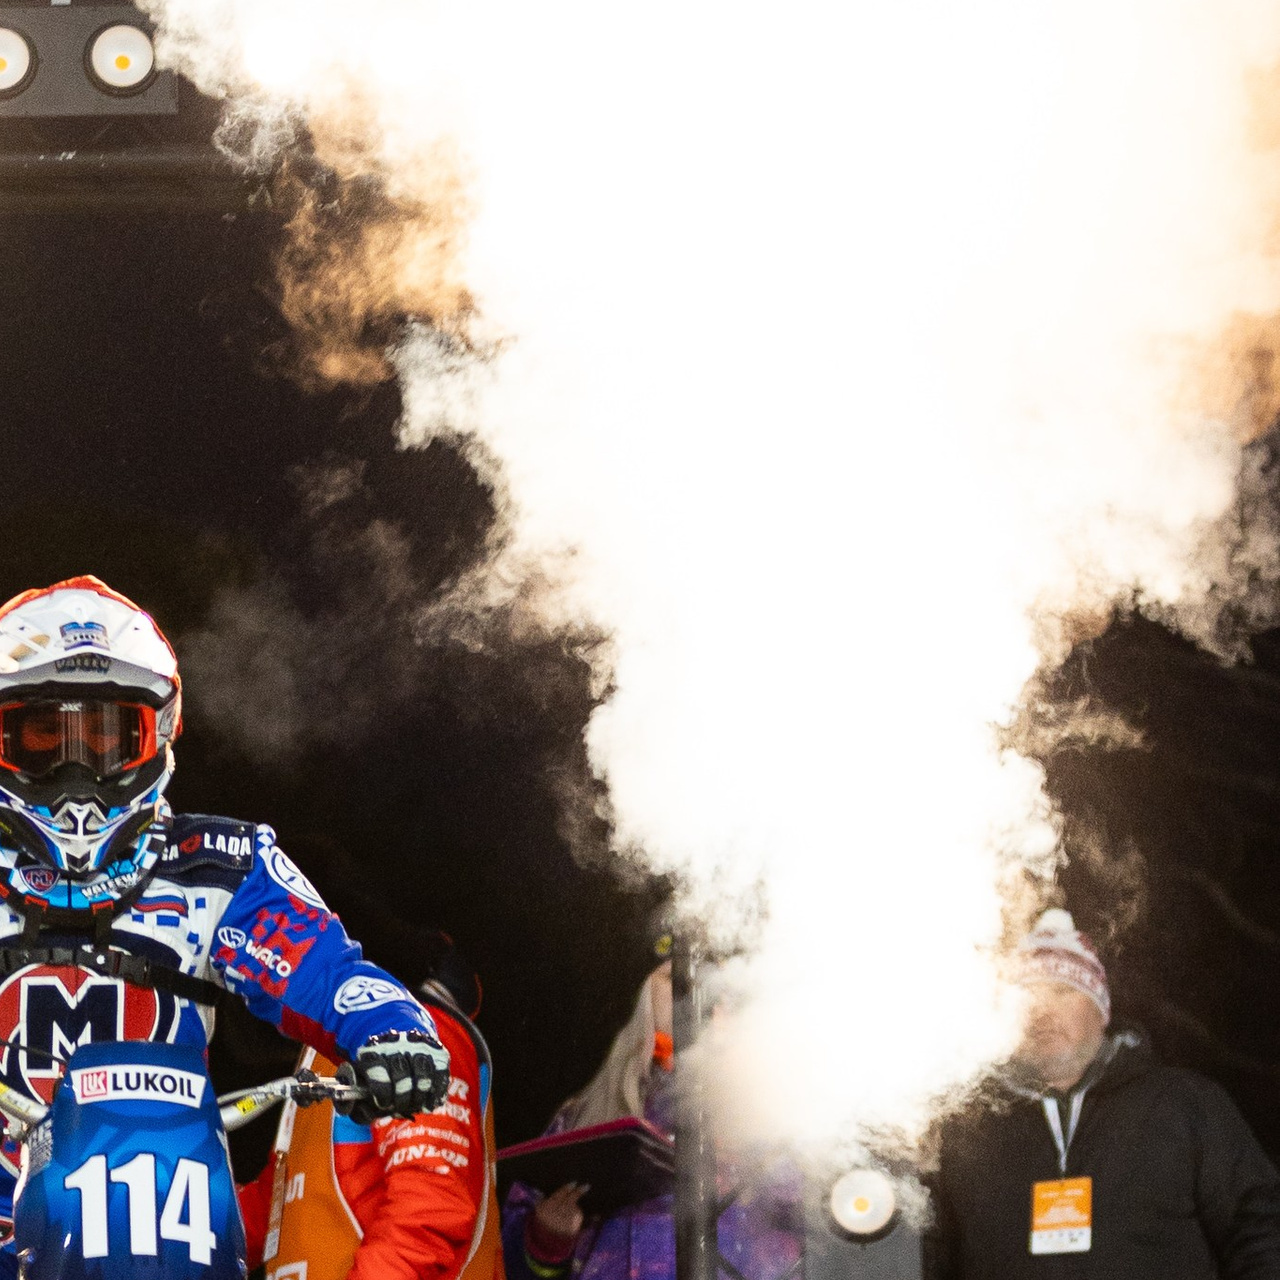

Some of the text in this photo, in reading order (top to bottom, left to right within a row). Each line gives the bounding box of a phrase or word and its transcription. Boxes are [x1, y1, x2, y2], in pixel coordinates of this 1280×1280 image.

[203, 832, 252, 857] LADA
[111, 1072, 197, 1100] LUKOIL
[385, 1143, 469, 1173] UNLOP
[64, 1153, 217, 1266] 114
